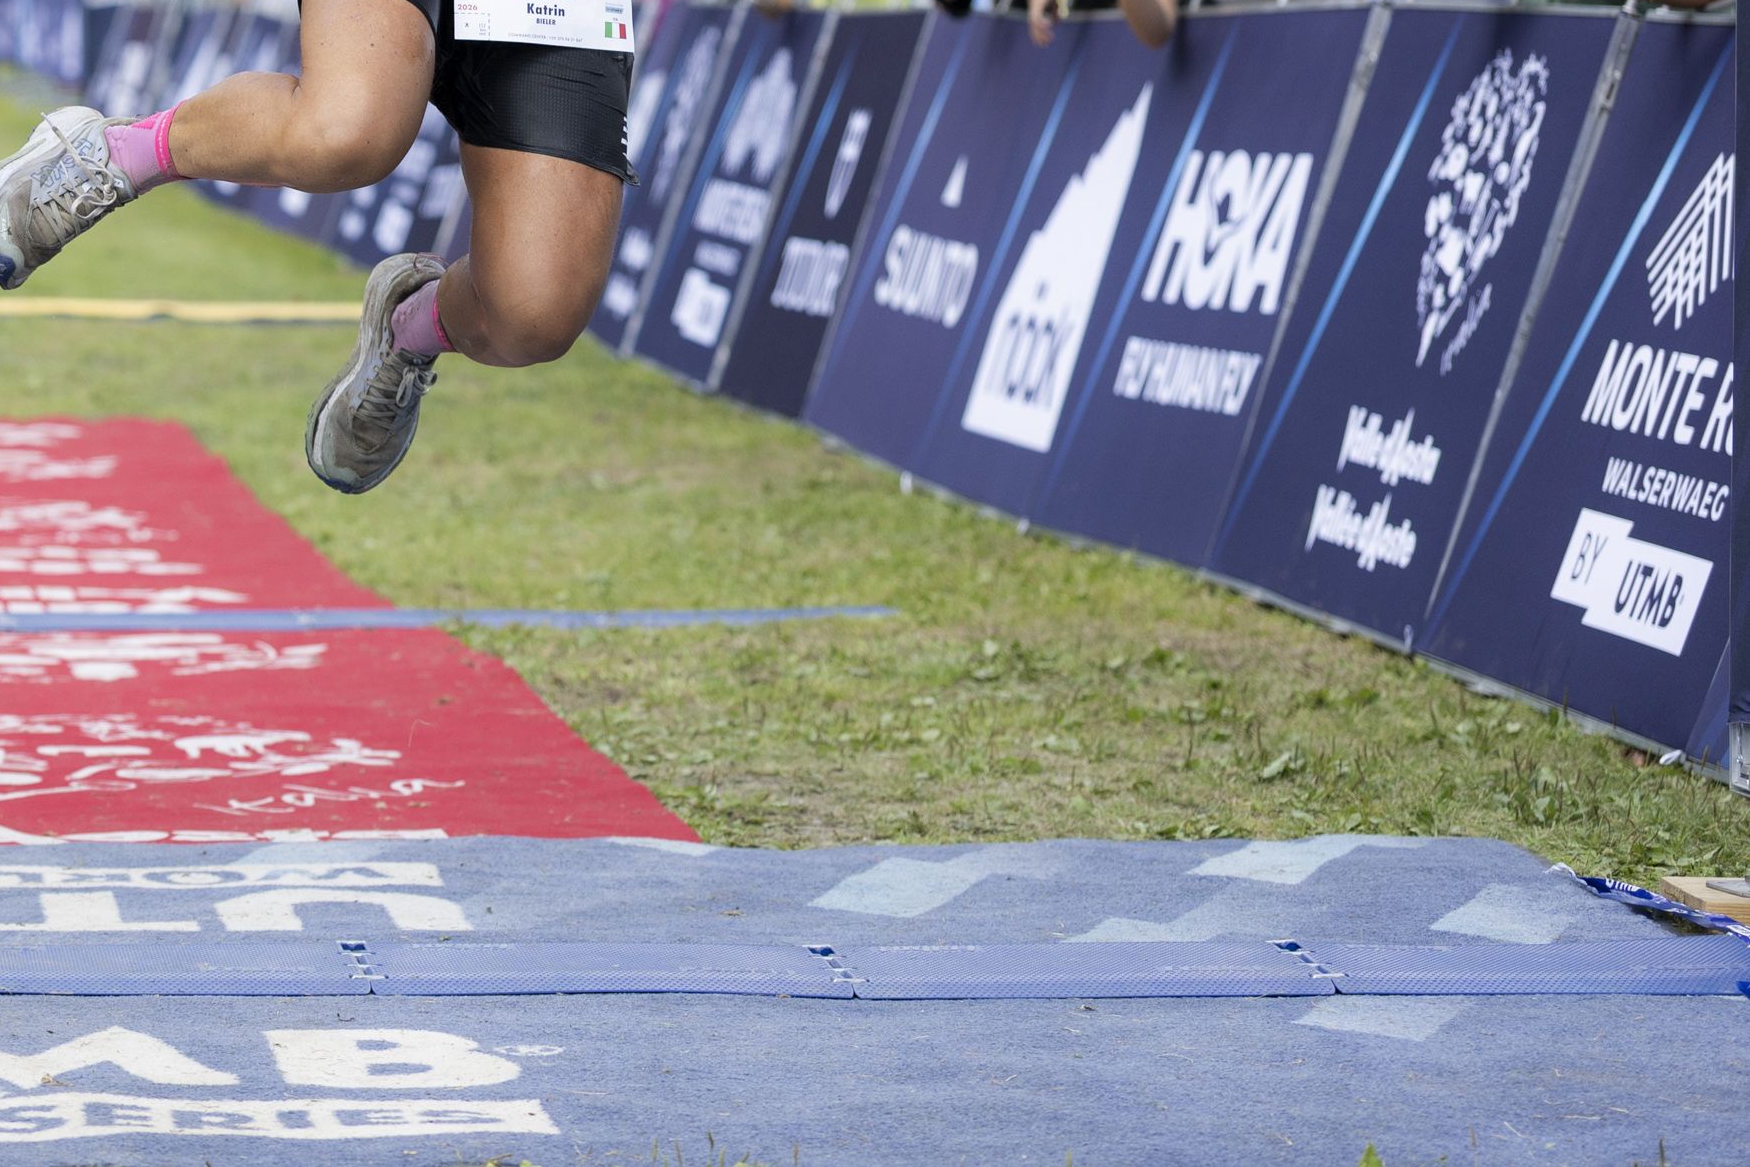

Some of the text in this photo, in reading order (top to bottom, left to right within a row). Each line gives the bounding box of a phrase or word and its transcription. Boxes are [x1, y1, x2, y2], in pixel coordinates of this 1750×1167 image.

[527, 3, 565, 16] Katrin
[875, 224, 979, 329] SUUNTO
[1141, 148, 1314, 316] HOKA
[1581, 337, 1704, 447] MONTE
[1600, 455, 1730, 522] WALSERWAEG
[1569, 529, 1682, 630] BY UTMB
